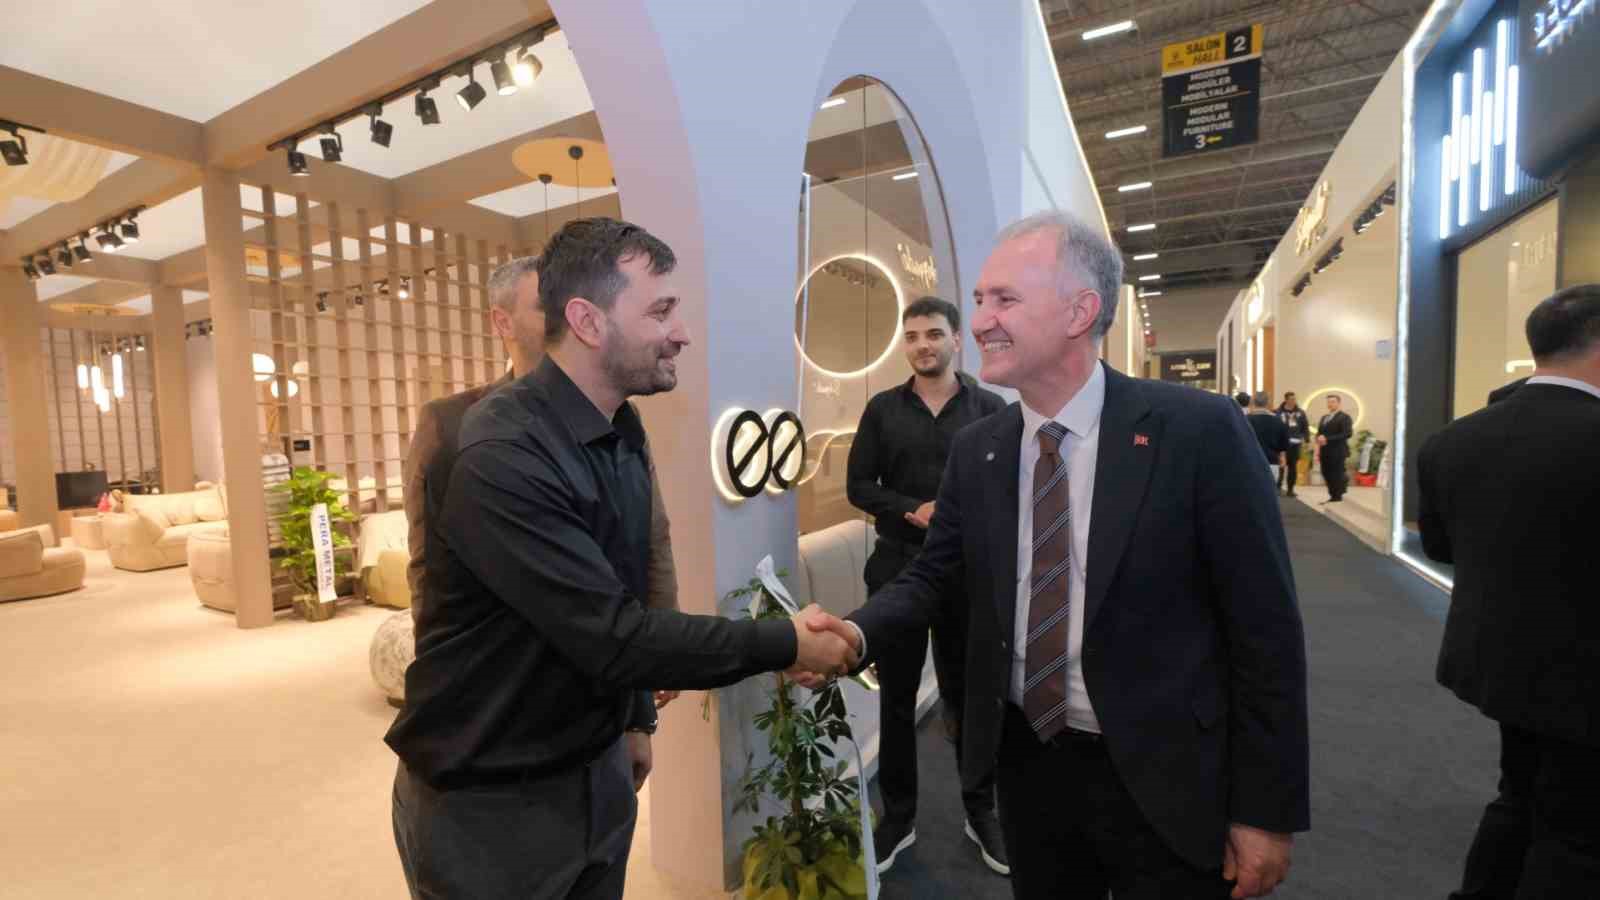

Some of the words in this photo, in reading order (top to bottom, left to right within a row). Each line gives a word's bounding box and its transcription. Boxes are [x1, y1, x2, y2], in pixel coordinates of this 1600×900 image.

[1186, 39, 1220, 55] SALON
[1233, 35, 1247, 52] 2
[1189, 102, 1229, 115] MODERN
[1195, 135, 1206, 149] 3
[319, 514, 329, 546] PERA
